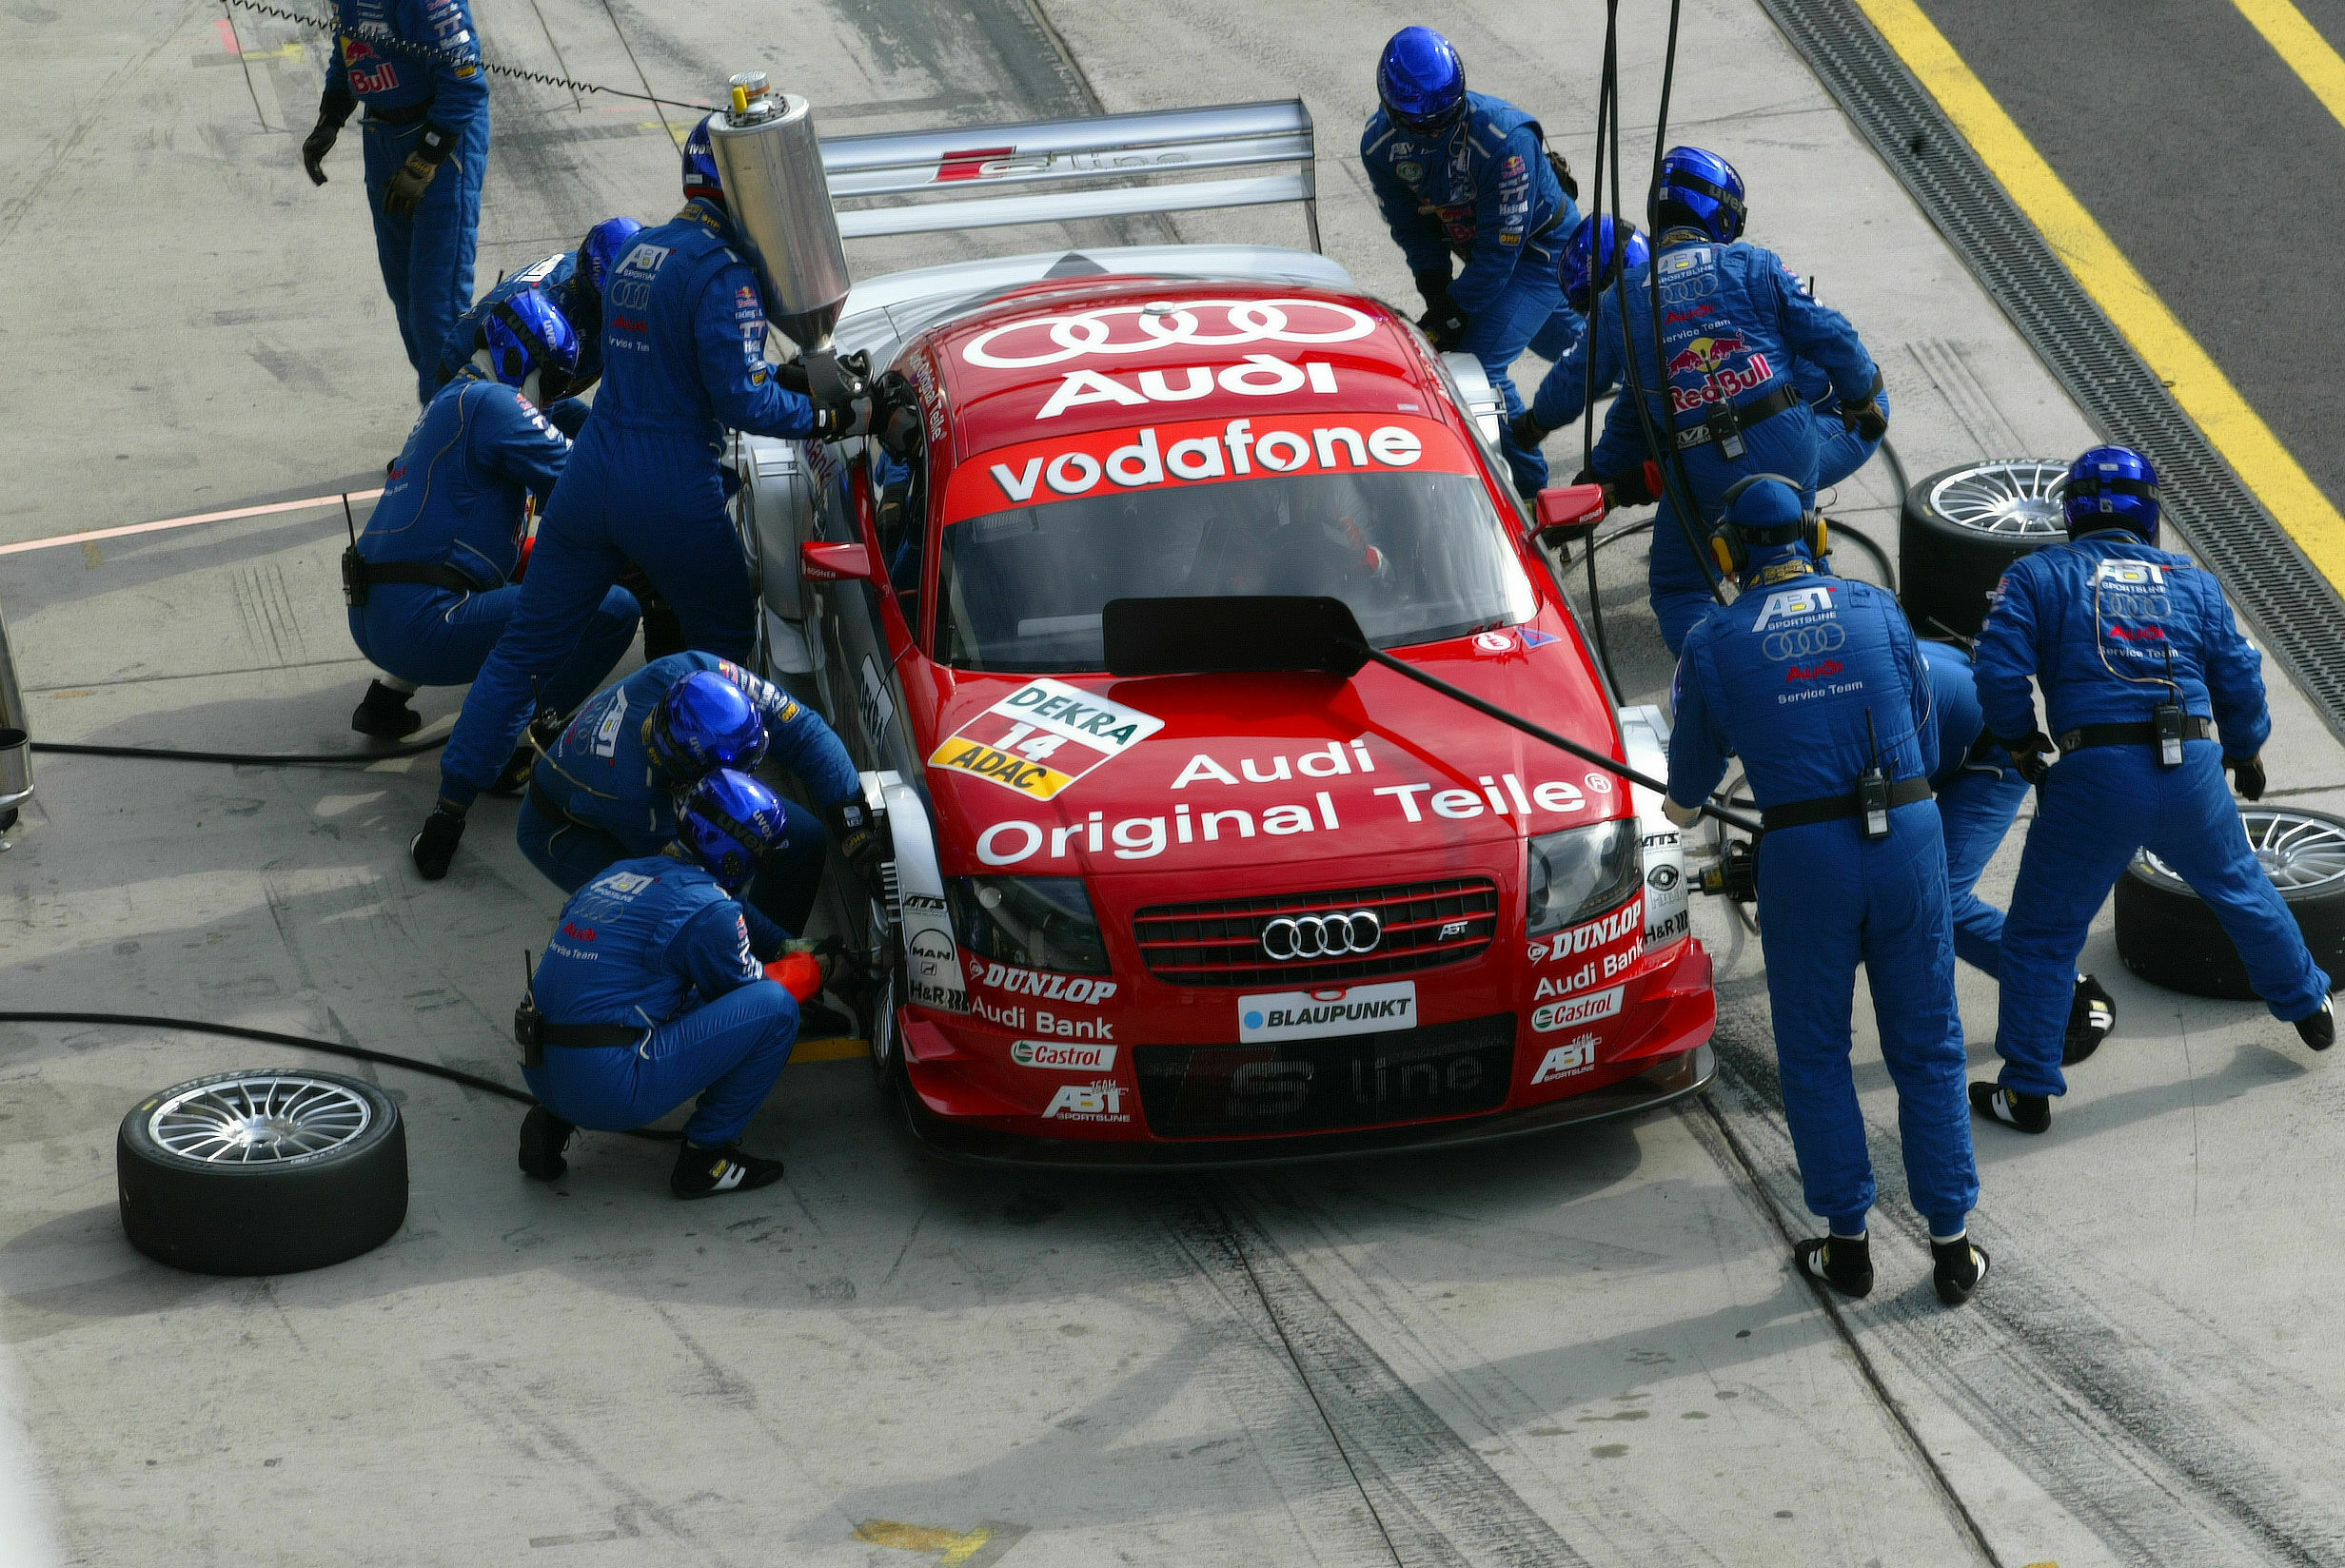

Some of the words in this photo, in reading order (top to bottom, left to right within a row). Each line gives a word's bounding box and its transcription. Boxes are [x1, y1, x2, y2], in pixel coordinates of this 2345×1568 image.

[348, 62, 400, 94] Bull
[1665, 304, 1715, 325] Audi
[1035, 354, 1338, 420] Audi
[1668, 373, 1720, 415] Red
[1716, 352, 1774, 398] Bull
[990, 419, 1423, 502] vodafone
[1752, 587, 1834, 633] ABT
[1767, 611, 1837, 631] SPORTSLINE
[2109, 624, 2165, 641] Audi
[1785, 659, 1843, 682] Audi
[1778, 687, 1825, 704] Service
[1828, 680, 1863, 695] Team
[1006, 687, 1137, 746] DEKRA
[993, 721, 1070, 762] 14
[948, 746, 1047, 789] ADAC
[1172, 738, 1375, 790] Audi
[753, 810, 774, 840] uvex
[975, 791, 1340, 867] Original
[590, 871, 655, 895] ABT
[1438, 921, 1468, 941] ABT
[1549, 898, 1643, 962] DUNLOP
[1644, 918, 1674, 945] H&R
[912, 947, 951, 961] MAN
[1533, 962, 1597, 1001] Audi
[1603, 935, 1645, 978] Bank
[911, 980, 945, 1005] H&R
[983, 963, 1118, 1006] DUNLOP
[972, 995, 1026, 1029] Audi
[1035, 1010, 1114, 1040] Bank
[1267, 997, 1412, 1029] BLAUPUNKT
[1554, 993, 1613, 1025] Castrol
[1035, 1045, 1103, 1067] Castrol
[1530, 1039, 1597, 1086] ABT
[1351, 1053, 1484, 1106] line
[1041, 1085, 1121, 1119] ABT
